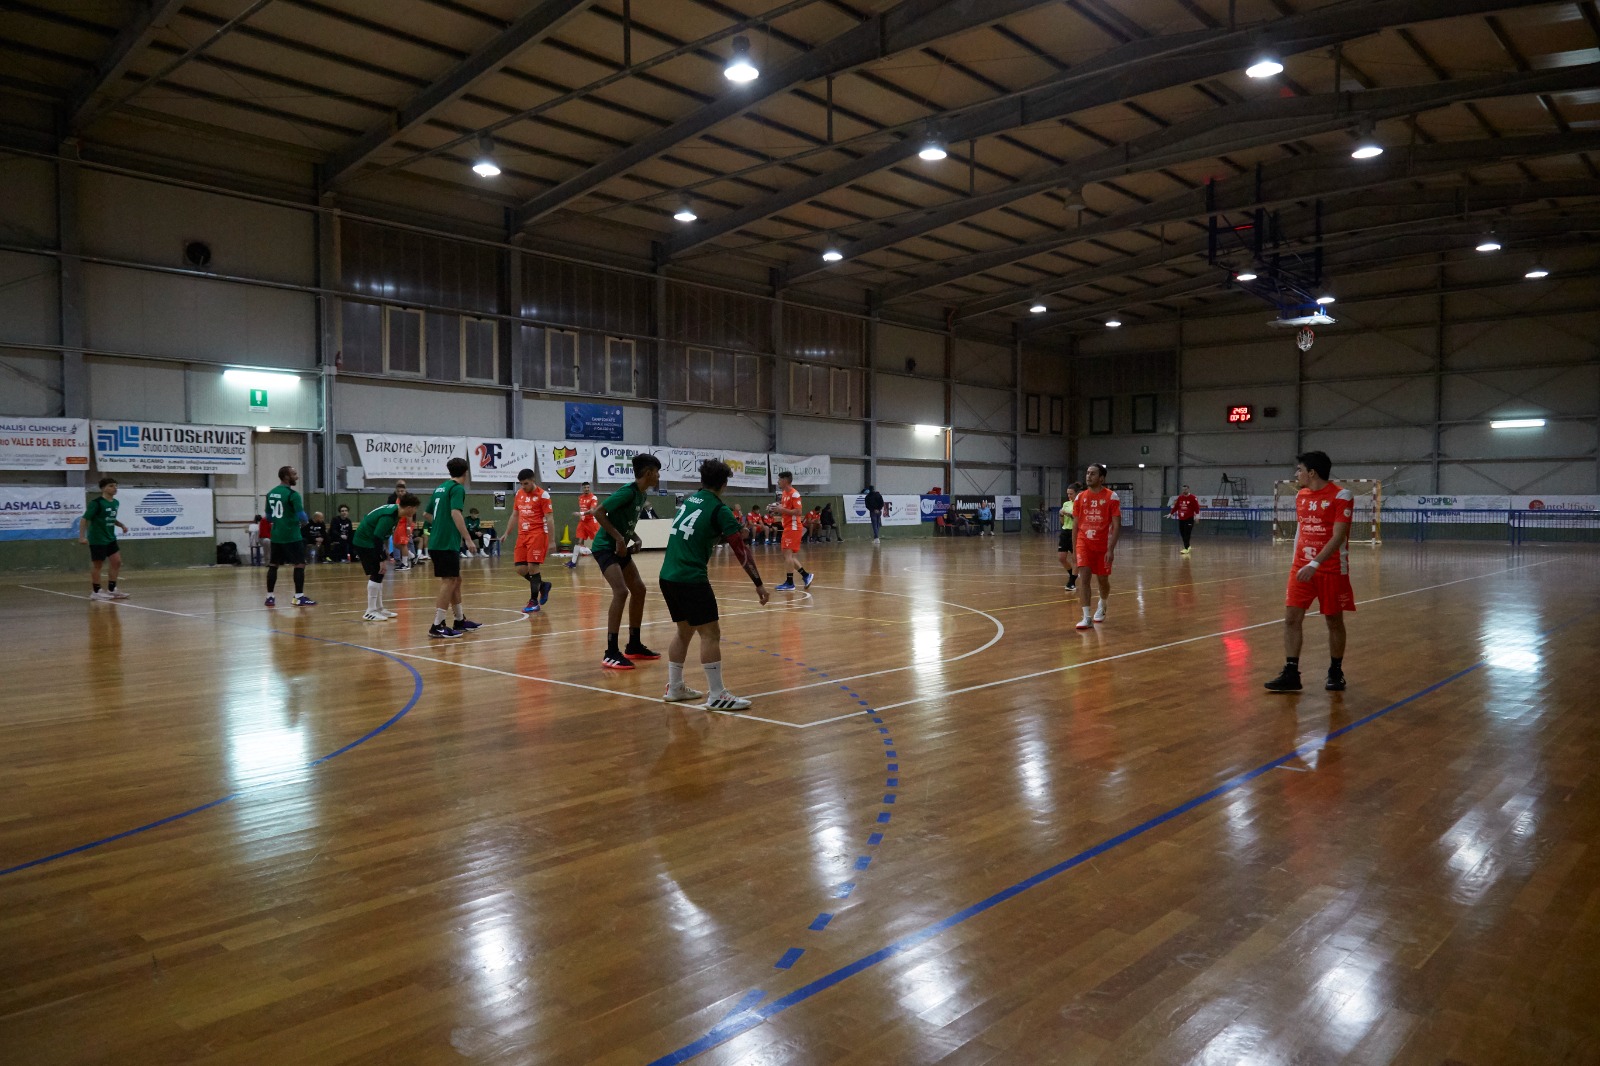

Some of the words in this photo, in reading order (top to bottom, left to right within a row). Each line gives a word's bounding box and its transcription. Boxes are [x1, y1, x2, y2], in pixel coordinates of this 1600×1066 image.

[28, 425, 67, 433] CLINICHE
[141, 427, 246, 446] AUTOSERVICE
[11, 438, 34, 447] VALLE
[36, 438, 51, 447] DEL
[52, 438, 76, 448] BELICE
[143, 444, 162, 453] STUDIO
[163, 445, 169, 453] DI
[169, 445, 201, 454] CONSULENZA
[202, 446, 246, 455] AUTOMOBILISTICA
[600, 446, 639, 458] ORTOPEDIA
[1307, 500, 1318, 511] 36
[1417, 496, 1458, 505] ORTOPEDIA
[268, 499, 284, 519] 50
